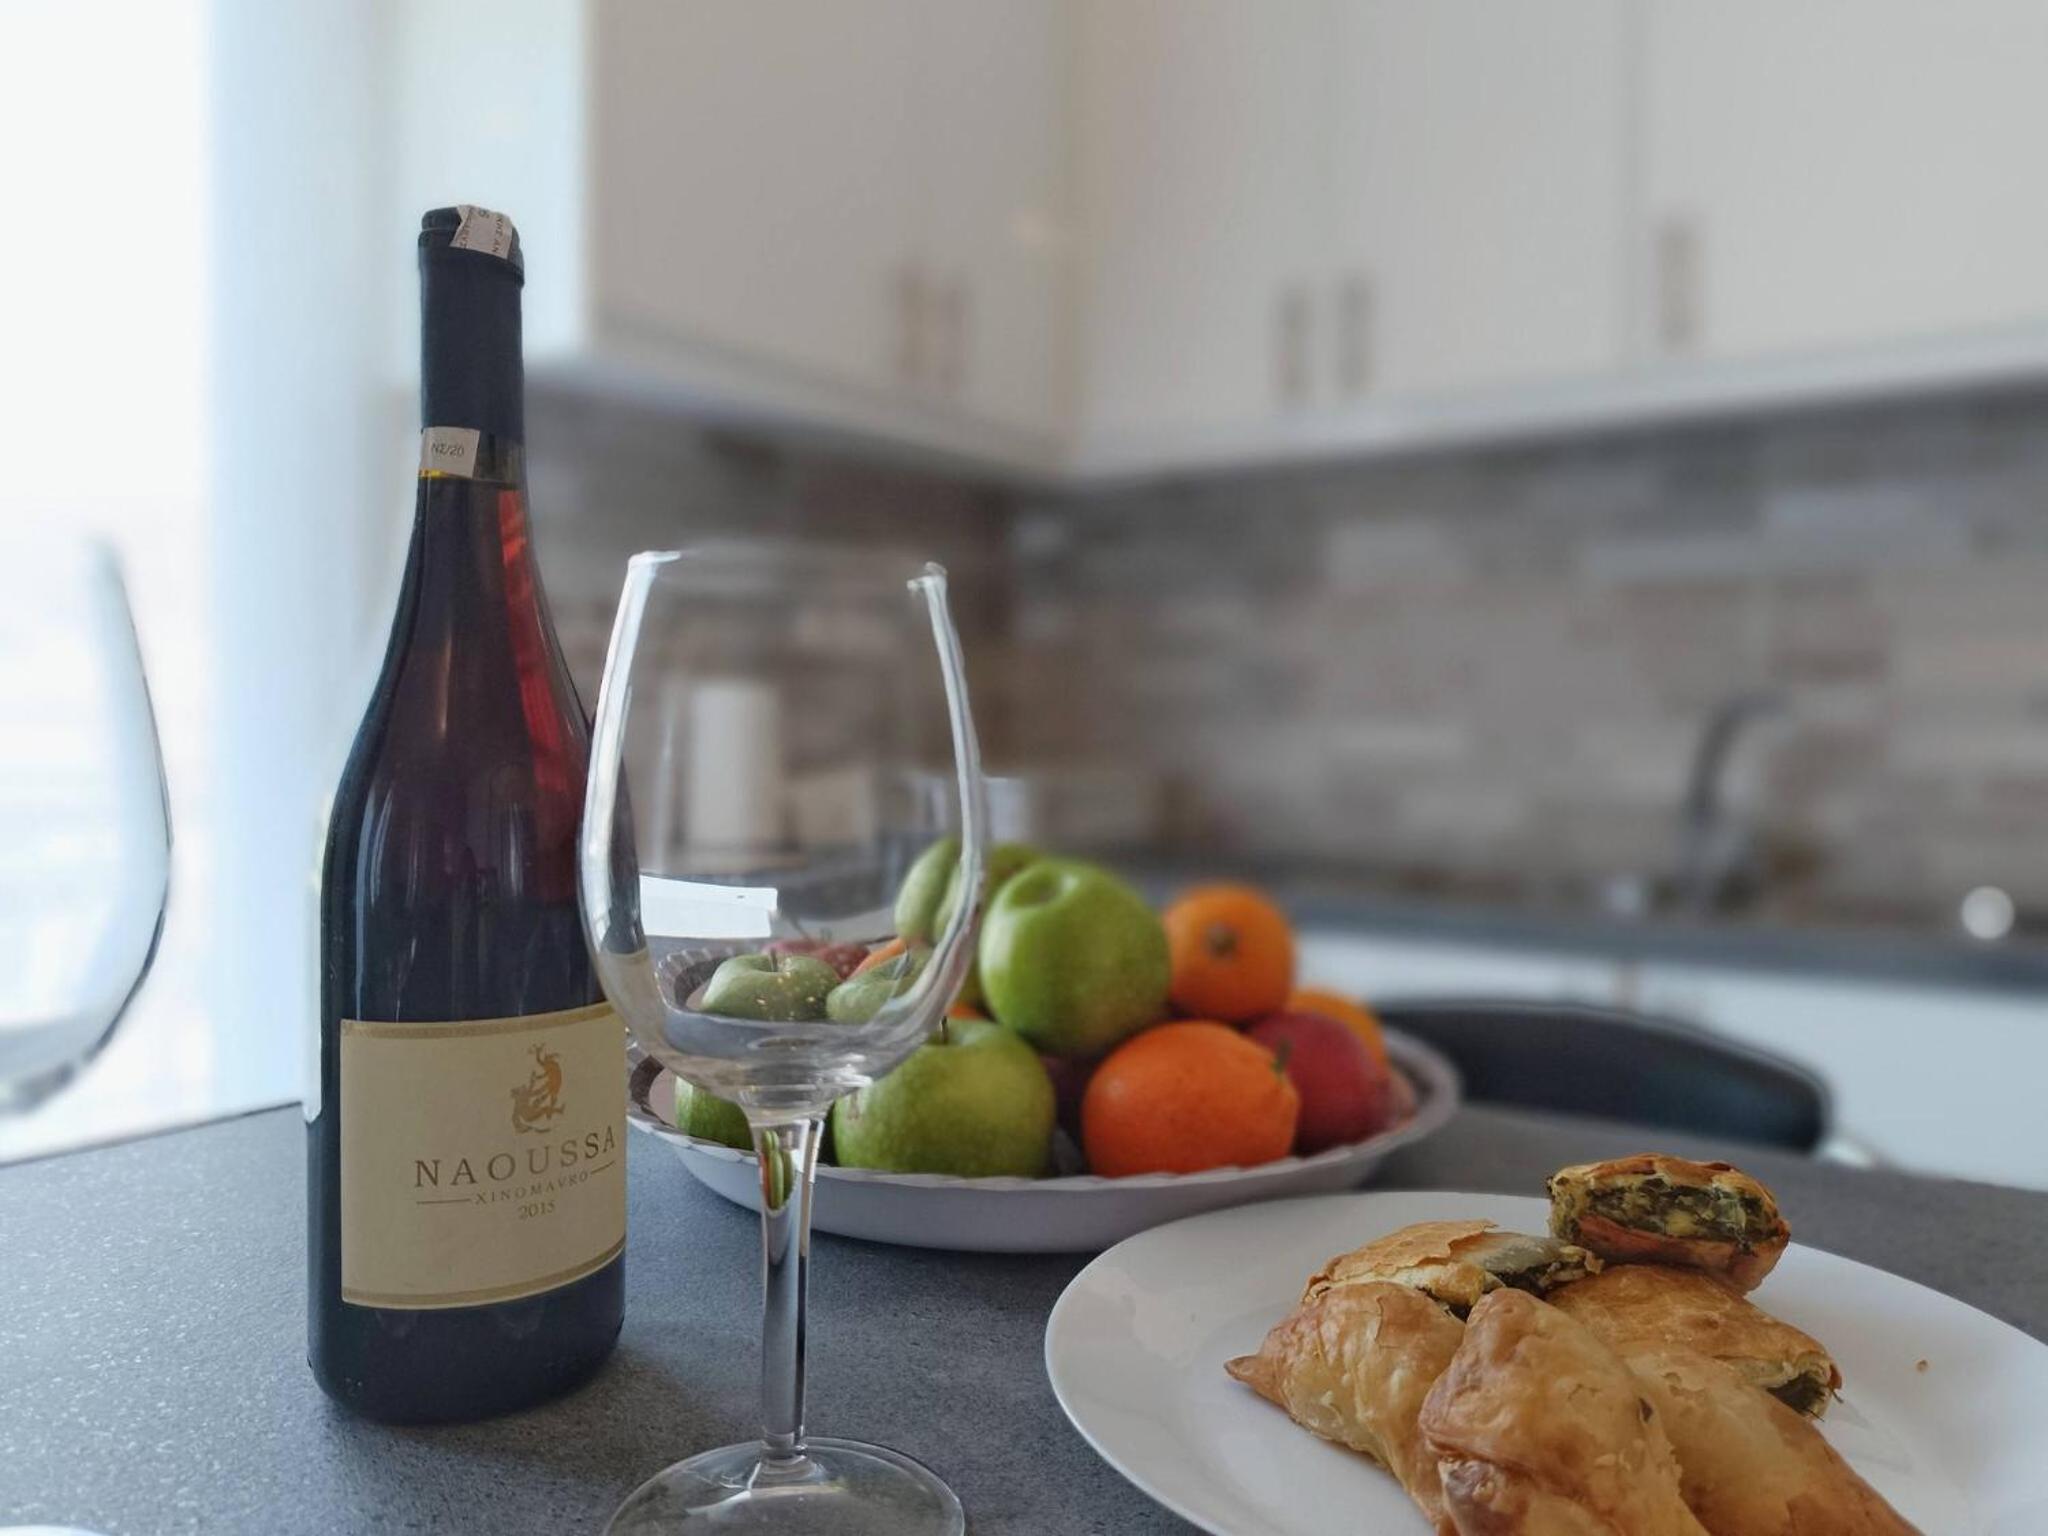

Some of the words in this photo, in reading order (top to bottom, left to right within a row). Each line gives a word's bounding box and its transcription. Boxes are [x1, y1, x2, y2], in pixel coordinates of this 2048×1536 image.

[415, 1125, 616, 1188] NAOUSSA
[474, 1170, 589, 1206] XINOMAVRO
[518, 1200, 556, 1221] 2015
